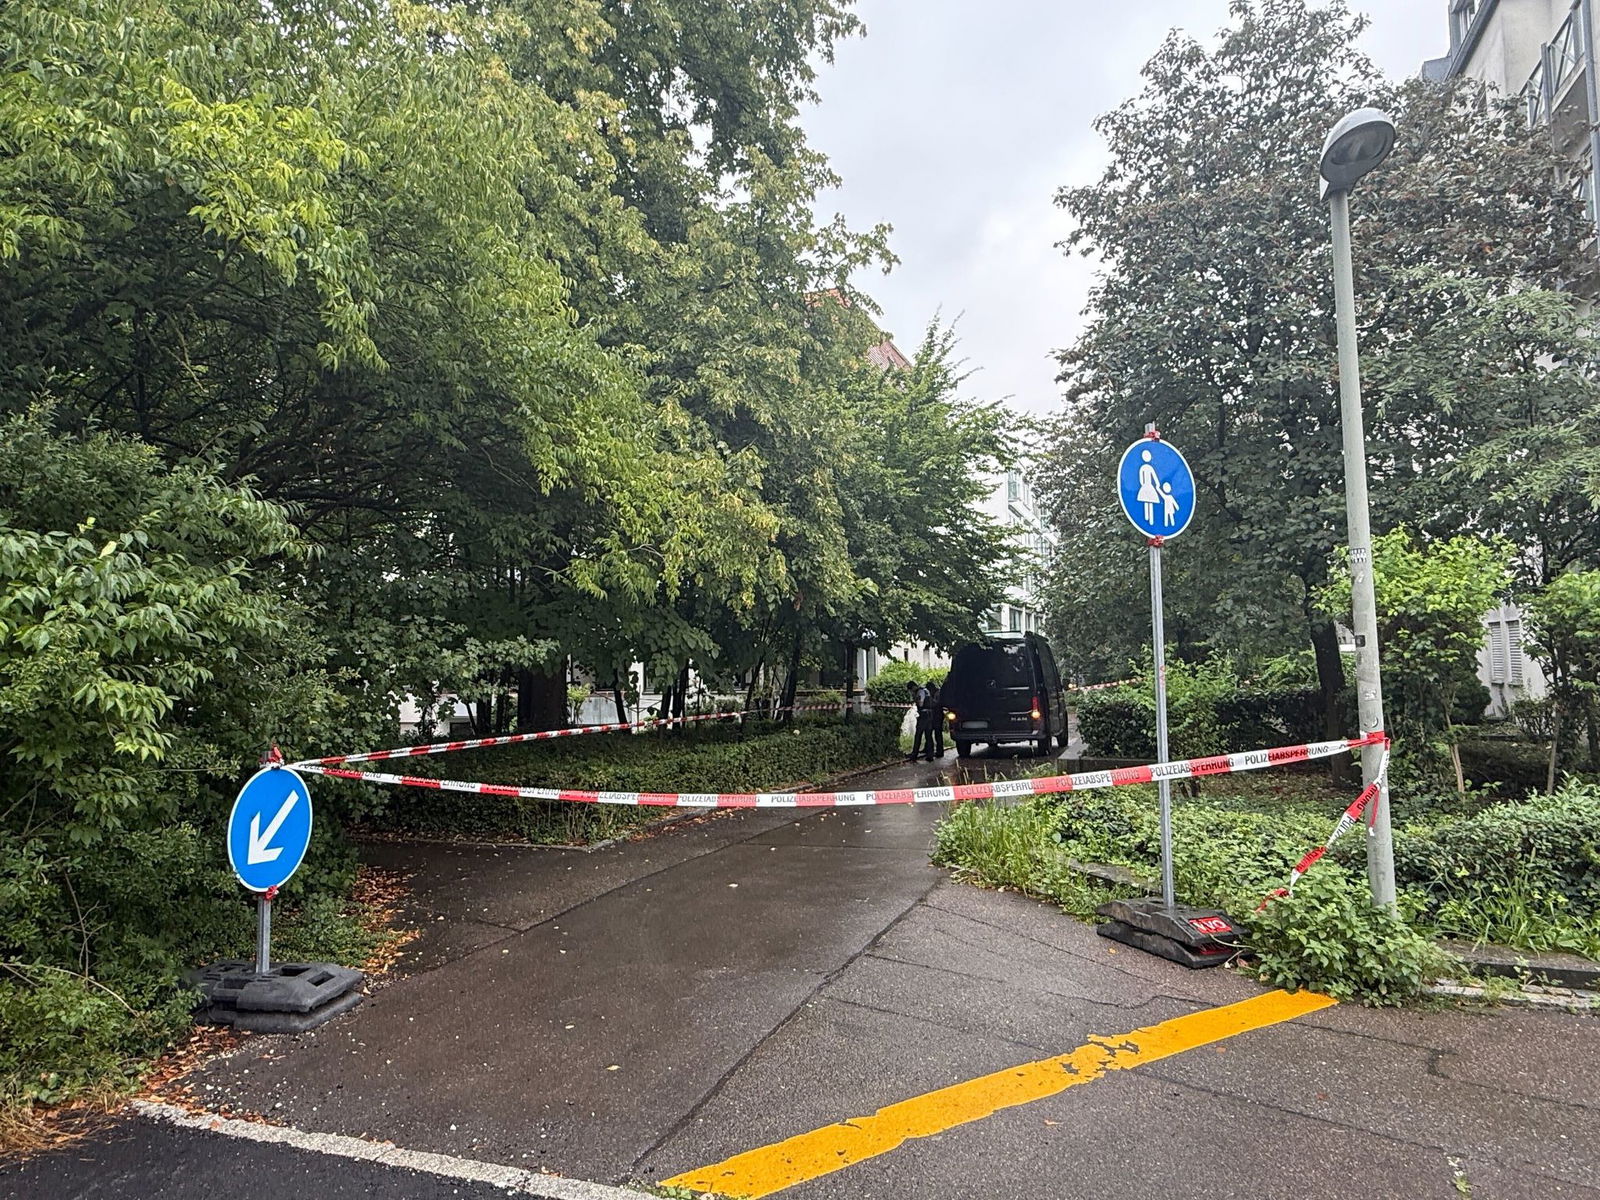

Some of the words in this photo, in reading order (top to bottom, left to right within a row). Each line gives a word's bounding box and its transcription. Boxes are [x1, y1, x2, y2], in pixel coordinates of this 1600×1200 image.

[771, 793, 856, 803] POLIZEIABSPERRUNG
[866, 788, 950, 801] POLIZEIABSPERRUNG
[960, 780, 1045, 796] POLIZEIABSPERRUNG
[1055, 769, 1139, 787] POLIZEIABSPERRUNG
[1150, 757, 1235, 777] POLIZEIABSPERRUNG
[1244, 745, 1329, 766] POLIZEIABSPERRUNG
